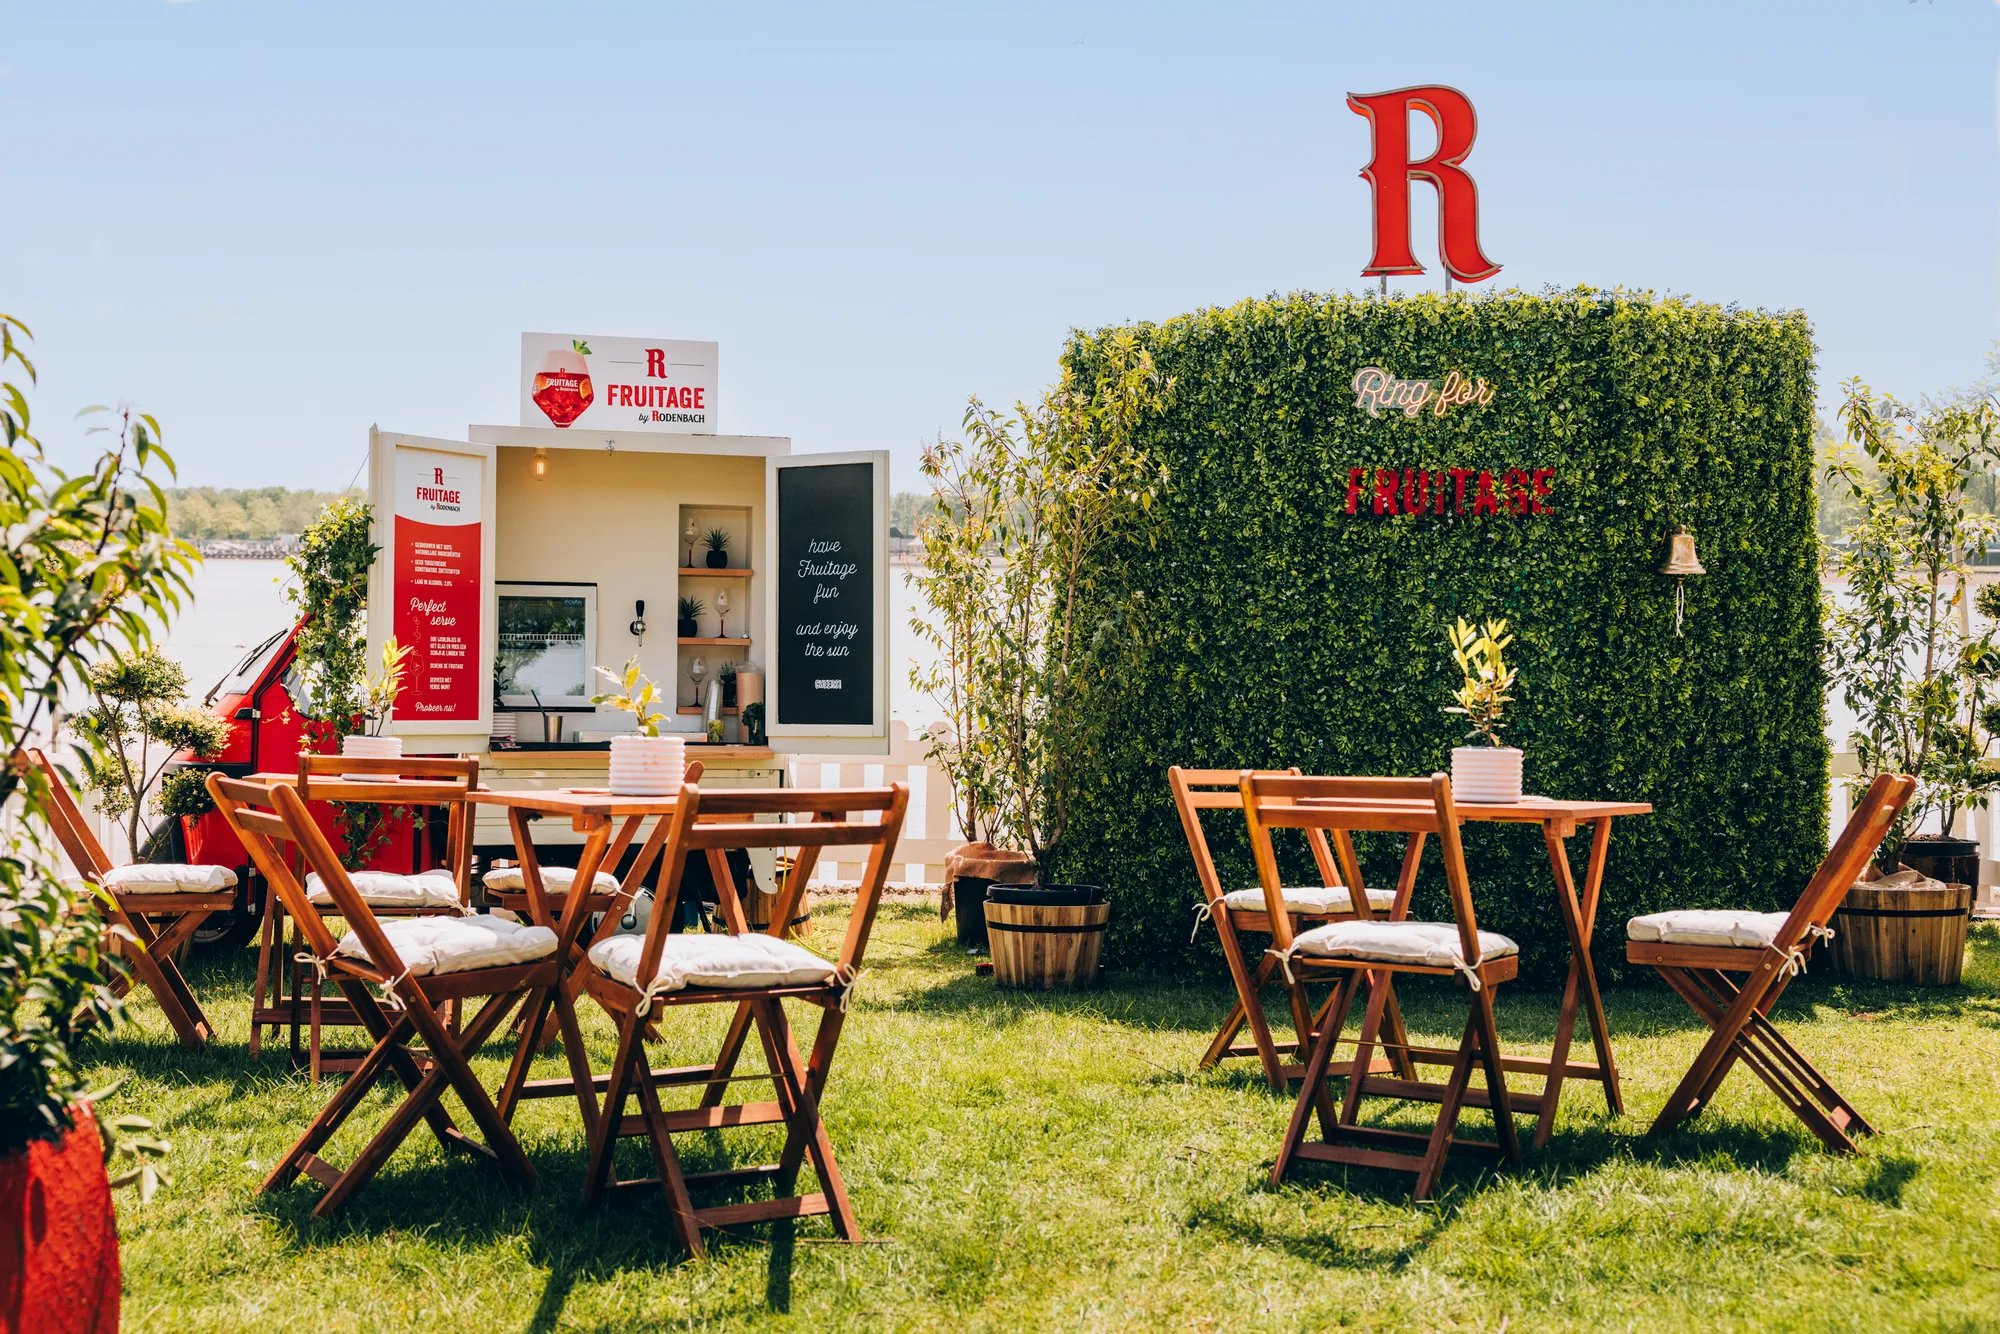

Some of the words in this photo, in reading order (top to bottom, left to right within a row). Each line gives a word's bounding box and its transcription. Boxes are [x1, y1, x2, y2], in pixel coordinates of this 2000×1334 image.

[1346, 84, 1504, 283] R
[645, 348, 668, 379] R
[546, 378, 579, 388] FRUITAGE
[1354, 367, 1433, 418] Ring
[1434, 370, 1494, 417] for
[607, 384, 705, 409] FRUITAGE
[638, 413, 649, 424] by
[652, 410, 705, 423] RODENBACH
[434, 467, 444, 485] R
[416, 487, 460, 503] FRUITAGE
[1345, 466, 1556, 515] FRUITAGE
[808, 538, 841, 554] have
[797, 559, 858, 580] Fruitage
[813, 583, 839, 604] fun
[410, 597, 447, 616] Perfect
[430, 616, 456, 627] serve
[796, 622, 822, 636] and
[823, 620, 858, 640] enjoy
[804, 642, 825, 657] the
[826, 645, 850, 657] sun
[415, 701, 443, 712] Probeer
[443, 703, 457, 712] nu!
